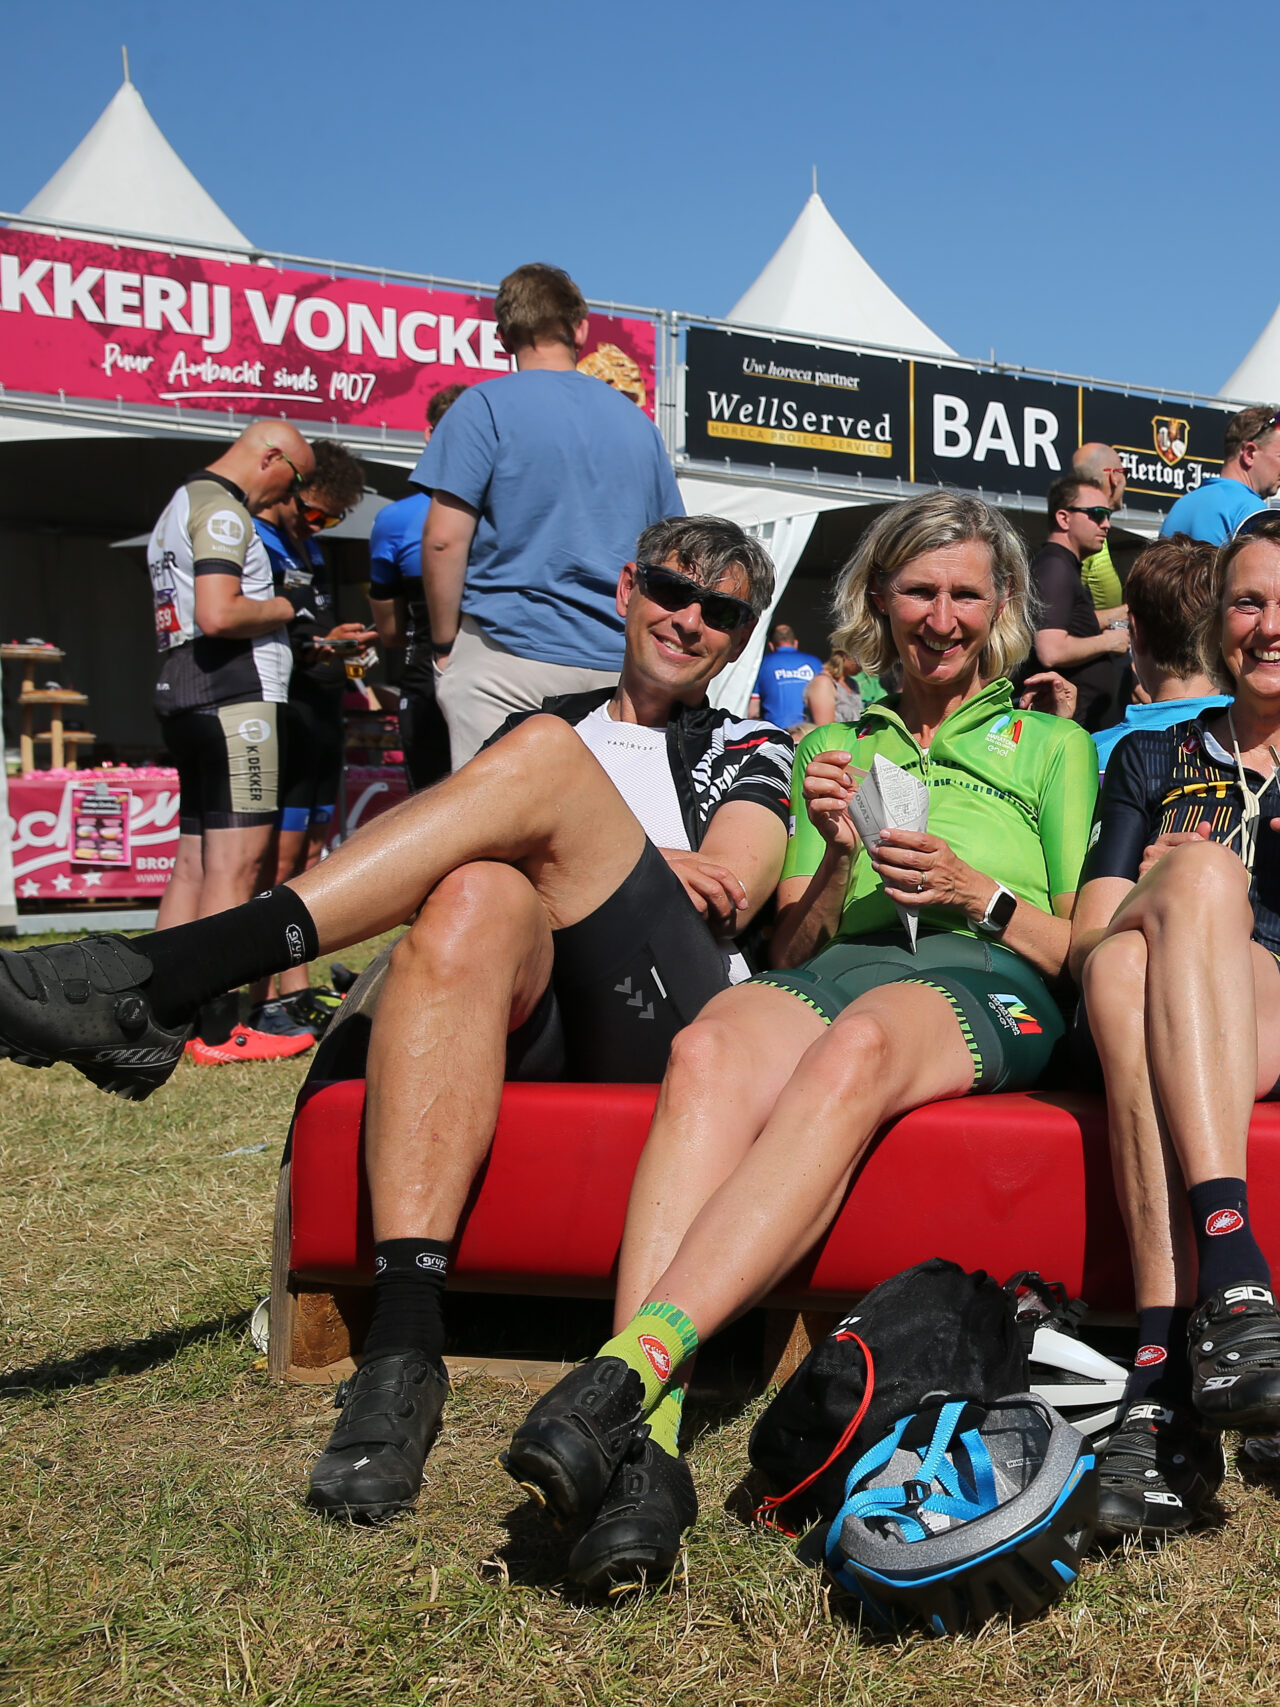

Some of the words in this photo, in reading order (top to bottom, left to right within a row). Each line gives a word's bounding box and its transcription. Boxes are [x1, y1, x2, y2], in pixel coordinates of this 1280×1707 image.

[0, 254, 231, 353] KKERIJ
[244, 289, 519, 372] VONCKE
[102, 343, 154, 377] Puur
[167, 350, 265, 387] Ambacht
[273, 366, 318, 391] sinds
[329, 371, 377, 404] 1907
[742, 357, 766, 374] Uw
[768, 361, 813, 381] horeca
[814, 371, 860, 388] partner
[707, 391, 892, 441] WellServed
[933, 393, 1062, 471] BAR
[710, 424, 764, 440] HORECA
[770, 431, 824, 447] PROJECT
[830, 439, 890, 456] SERVICES
[248, 757, 262, 802] DEKKER
[1224, 1286, 1274, 1305] SIDI
[1202, 1375, 1241, 1391] SIDI
[1125, 1404, 1174, 1424] SIDI
[1143, 1491, 1183, 1508] SIDI
